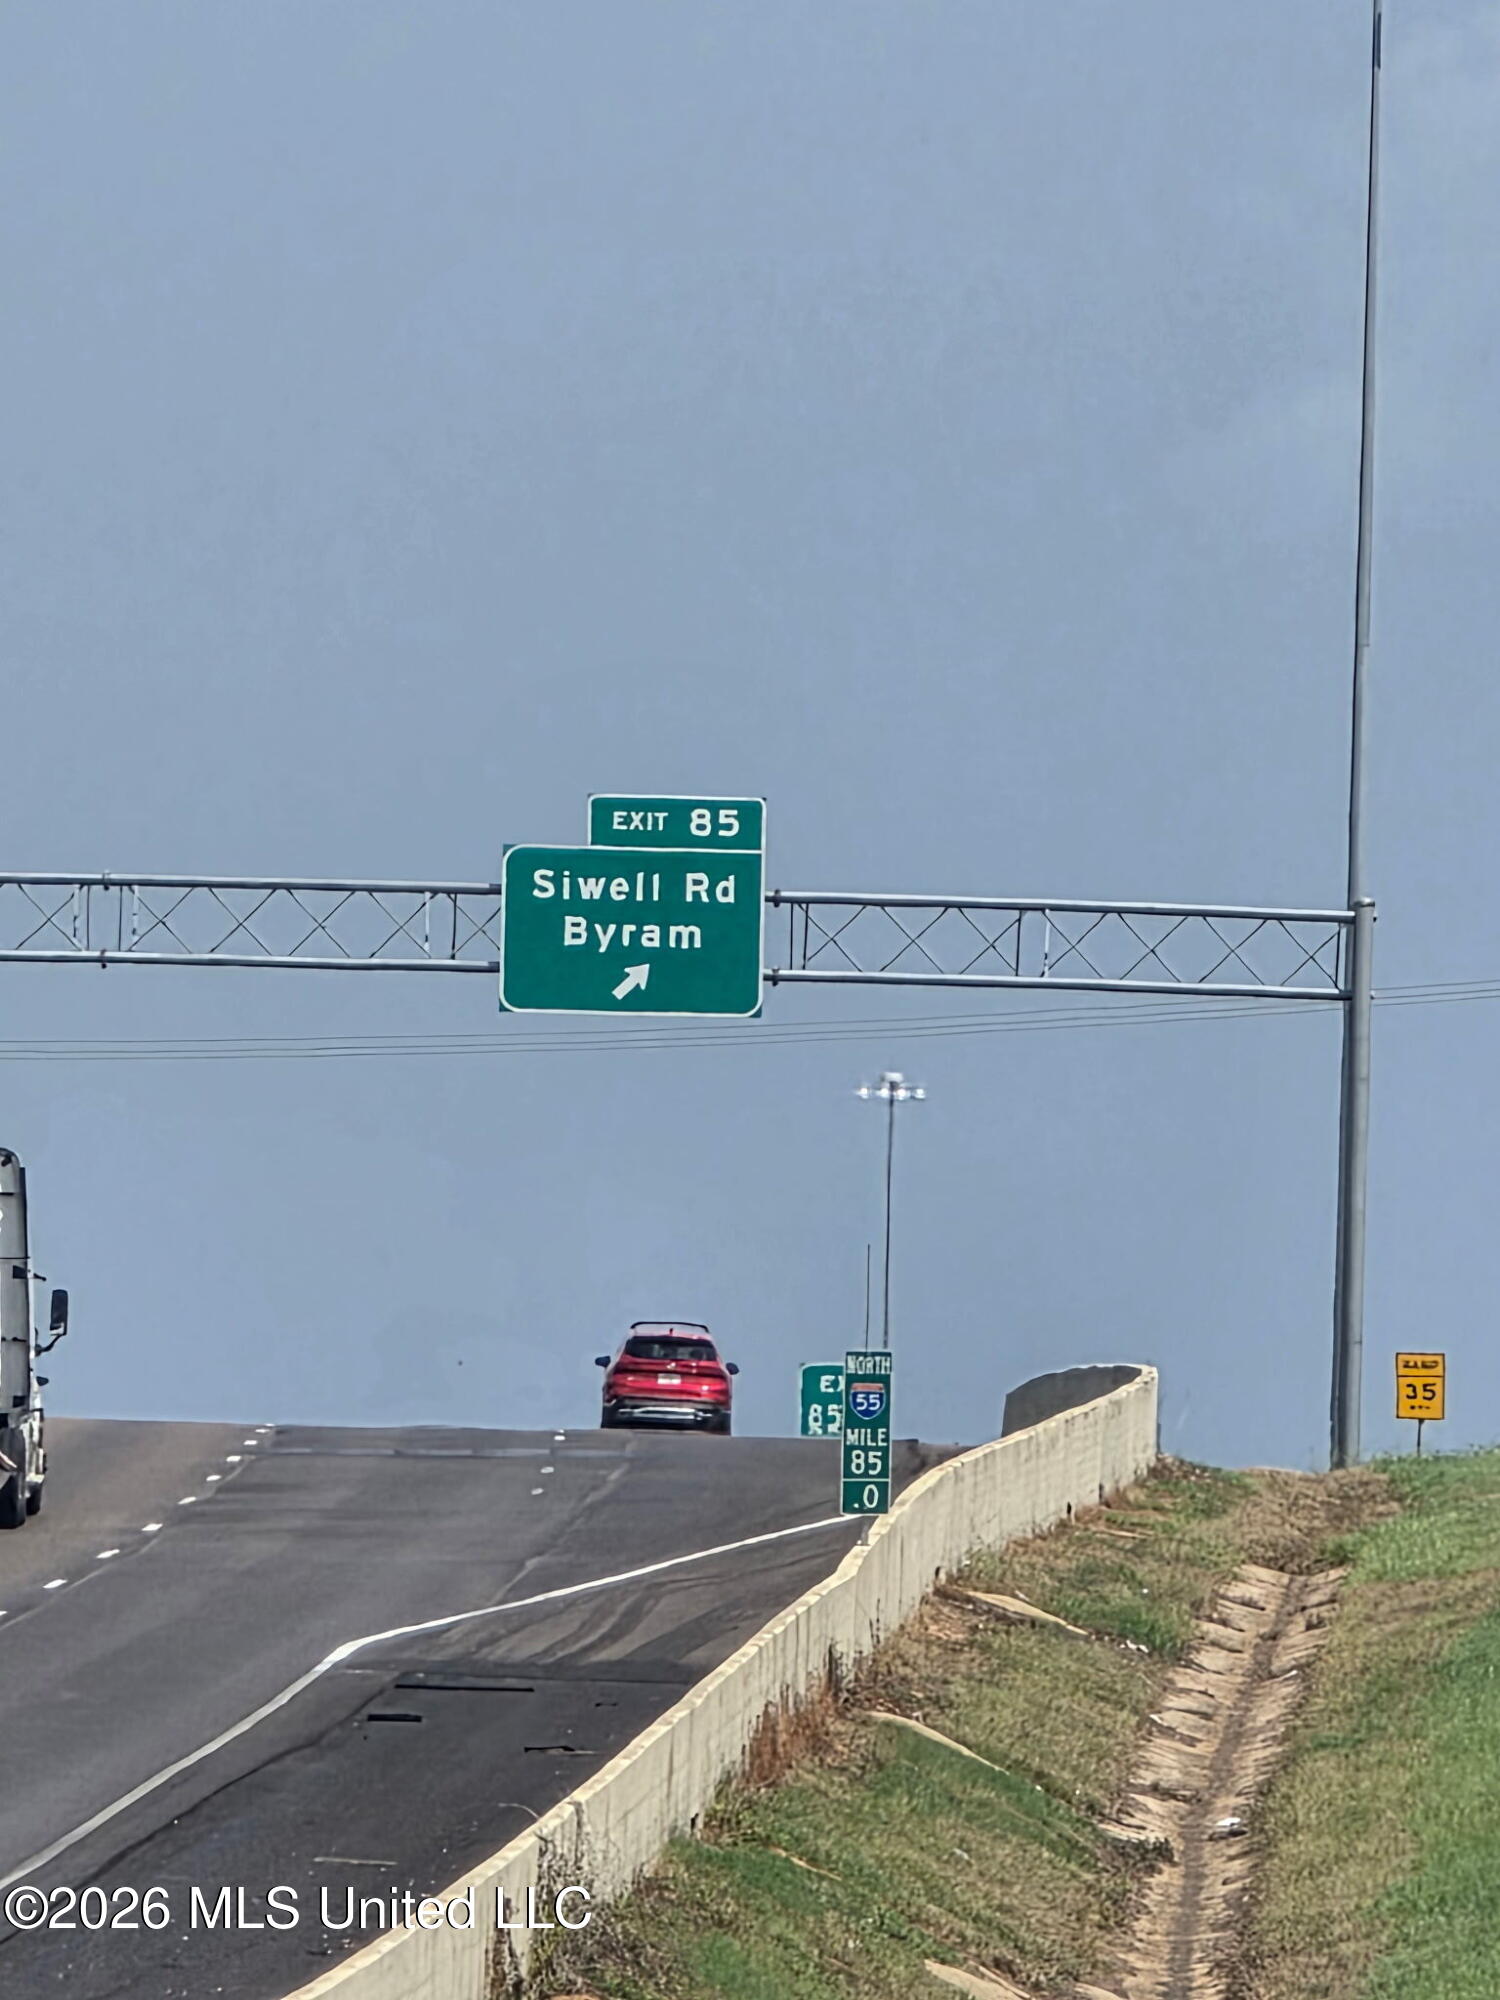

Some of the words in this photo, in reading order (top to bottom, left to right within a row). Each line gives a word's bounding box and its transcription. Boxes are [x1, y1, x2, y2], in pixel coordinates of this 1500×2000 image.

[612, 811, 668, 831] EXIT
[690, 809, 740, 836] 85
[533, 869, 660, 901] Siwell
[685, 872, 735, 903] Rd
[564, 915, 702, 953] Byram
[847, 1355, 891, 1374] NORTH
[856, 1394, 881, 1411] 55
[1406, 1383, 1437, 1401] 35
[846, 1428, 888, 1446] MILE
[851, 1450, 882, 1475] 85
